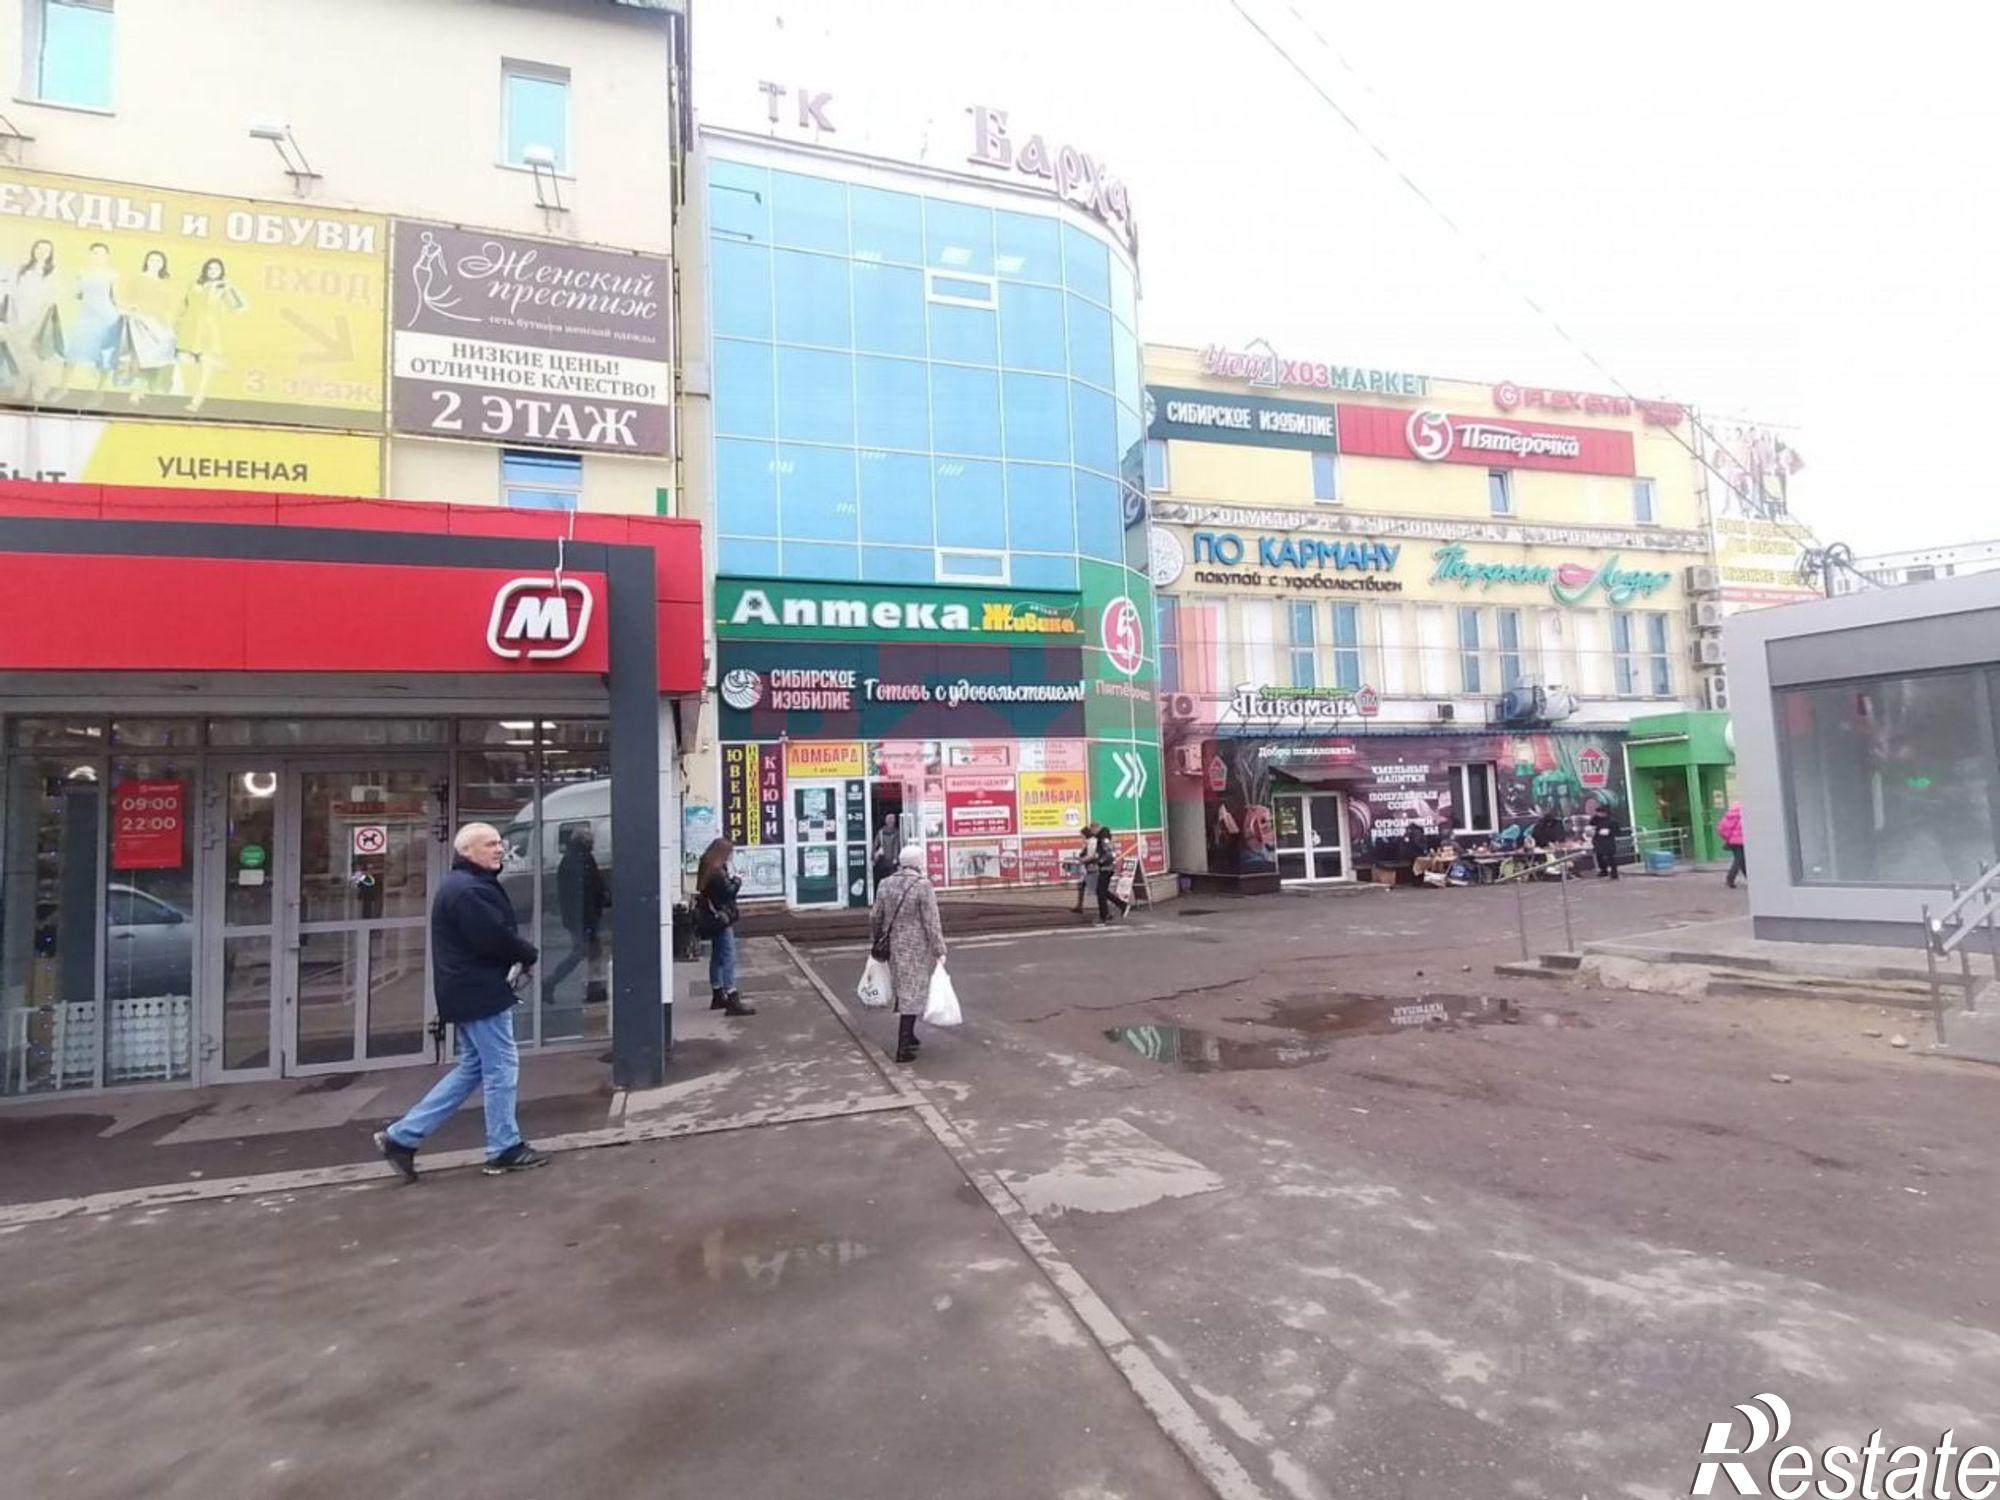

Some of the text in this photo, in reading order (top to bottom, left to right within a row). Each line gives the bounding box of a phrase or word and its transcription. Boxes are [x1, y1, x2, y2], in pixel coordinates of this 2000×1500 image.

[758, 78, 835, 131] ТК
[965, 104, 1140, 260] Барха
[182, 213, 208, 238] и
[226, 209, 375, 254] ОБУВИ
[264, 264, 371, 304] ВХОД
[457, 241, 655, 299] Женский
[487, 279, 658, 321] престиж
[452, 342, 620, 377] НИЗКИЕ ЦЕНЫ!
[245, 369, 267, 393] 3
[410, 357, 656, 399] ОТЛИЧНОЕ КАЧЕСТВО!
[1284, 360, 1430, 395] ХОЗМАРКЕТ
[431, 390, 638, 446] 2 ЭТАЖ
[1167, 401, 1334, 436] СИБИРСКОЕ ИЗОБИЛИЕ
[1417, 423, 1443, 453] 5
[157, 457, 308, 482] УЦЕНЕНАЯ
[1193, 532, 1401, 572] ПО КАРМАНУ
[1195, 570, 1402, 592] покупай с удовольствием
[731, 589, 970, 630] Аптека
[770, 668, 857, 689] СИБИРСКОЕ
[864, 678, 1086, 708] Готовь с удовольствием!
[772, 691, 851, 711] ИЗОБИЛИЕ
[1232, 689, 1355, 717] Пивоман
[790, 748, 860, 763] ЛОМБАРД
[1371, 764, 1430, 775] ХМЕЛЬНЫЕ
[122, 797, 177, 812] 09:00
[726, 749, 743, 842] ЮВЕЛИР
[763, 756, 779, 836] КЛЮЧИ
[1024, 789, 1082, 804] ЛОМБАРД
[122, 816, 177, 831] 22:00
